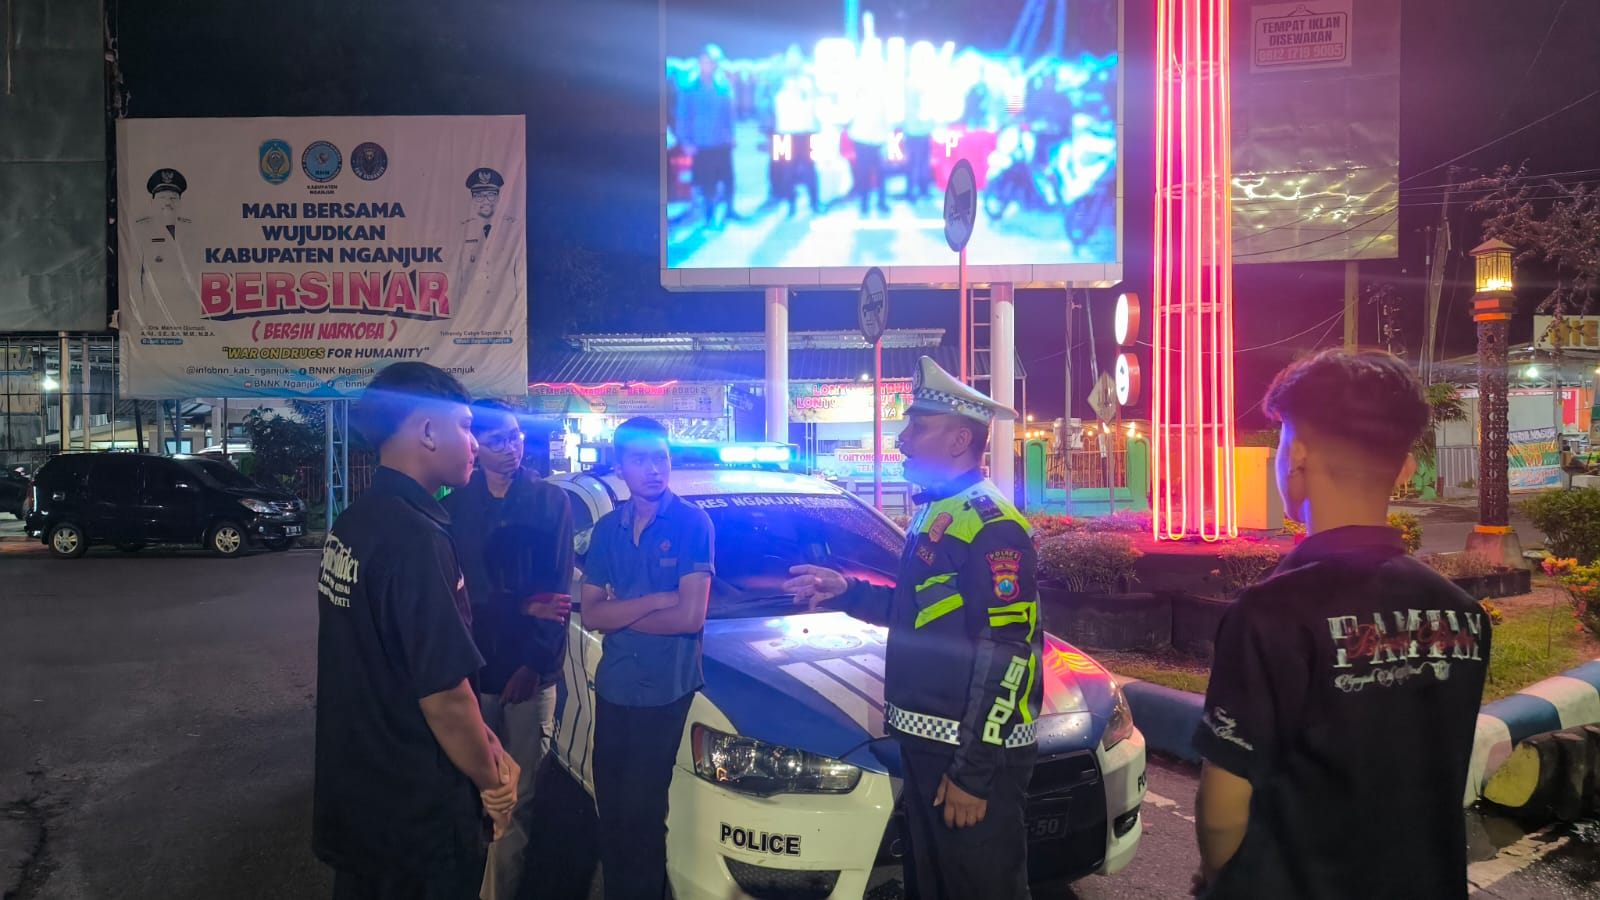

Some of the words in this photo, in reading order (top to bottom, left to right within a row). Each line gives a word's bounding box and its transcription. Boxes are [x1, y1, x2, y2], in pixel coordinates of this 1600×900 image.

[1263, 20, 1305, 34] TEMPAT
[1309, 16, 1340, 29] IKLAN
[1269, 30, 1333, 46] DISEWAKAN
[242, 203, 298, 219] MARI
[303, 202, 406, 219] BERSAMA
[262, 225, 386, 245] WUJUDKAN
[205, 248, 334, 264] KABUPATEN
[339, 247, 443, 267] NGANJUK
[200, 270, 451, 321] BERSINAR
[263, 322, 316, 340] BERSIH
[317, 321, 385, 340] NARKOBA
[259, 347, 283, 359] ON
[283, 347, 326, 360] DRUGS
[326, 348, 353, 358] FOR
[308, 366, 336, 375] BNNK
[338, 367, 375, 376] Nganjuk
[254, 380, 281, 388] BNNK
[283, 380, 320, 390] Nganjuk
[880, 453, 901, 462] TAHU
[731, 496, 805, 507] NGANJUK
[982, 655, 1028, 746] POLISI
[720, 822, 802, 857] POLICE
